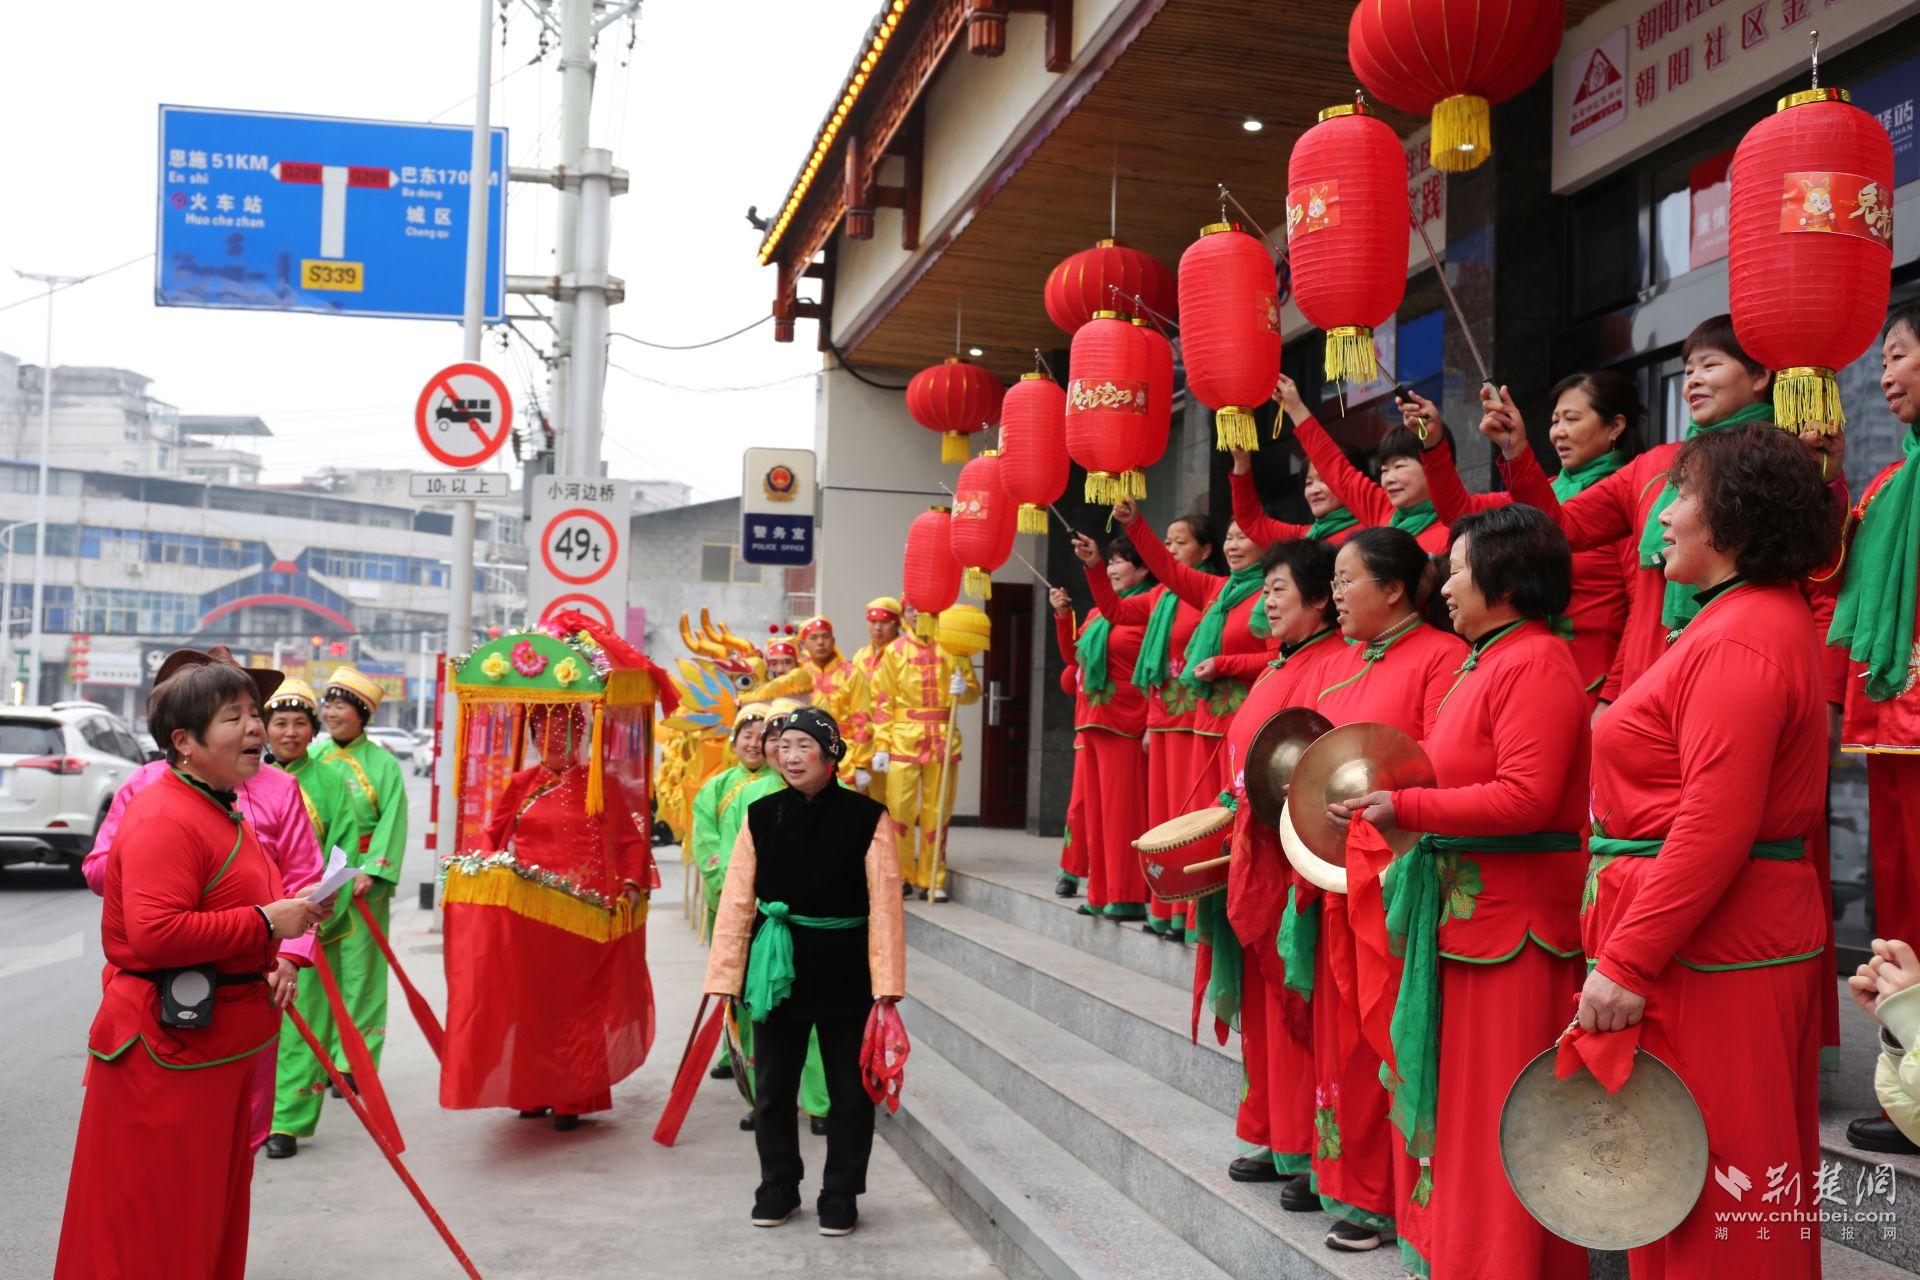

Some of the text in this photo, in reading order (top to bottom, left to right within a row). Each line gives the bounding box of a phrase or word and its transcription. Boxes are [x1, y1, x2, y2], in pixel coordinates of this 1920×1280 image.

[1637, 0, 1727, 50] 朝阳社
[211, 153, 269, 172] 51KM
[168, 171, 209, 185] En shi
[189, 192, 263, 214] 火车站
[185, 213, 266, 229] Huo che zhan
[405, 205, 452, 226] 城区
[308, 264, 357, 285] S339
[547, 481, 615, 502] 小河边桥
[753, 525, 806, 540] 警务室
[554, 527, 601, 562] 49t
[752, 543, 805, 552] POLICE OFFICE
